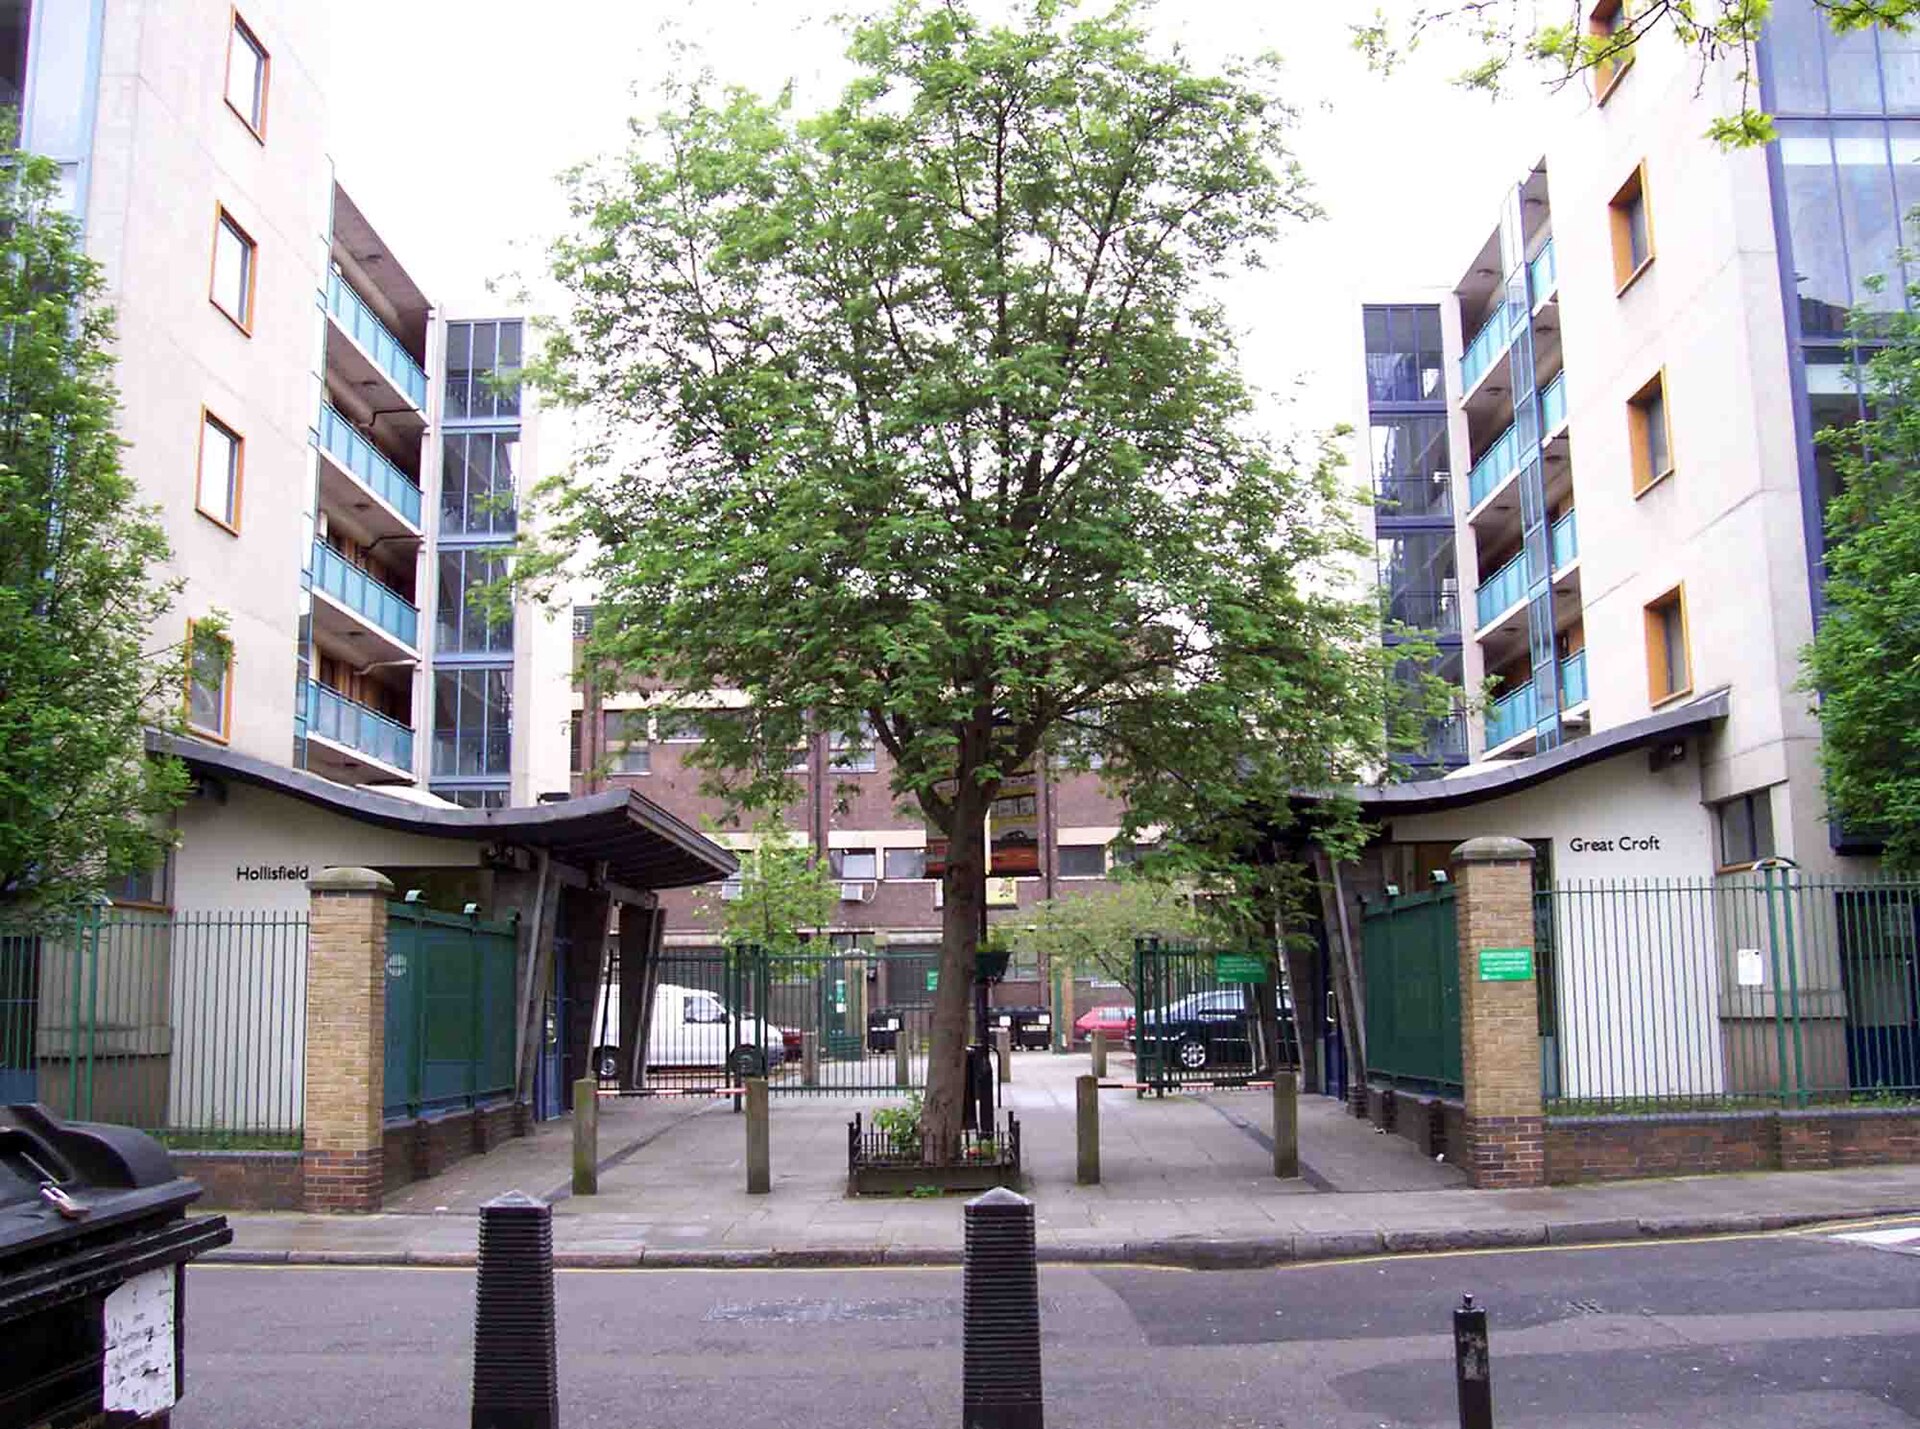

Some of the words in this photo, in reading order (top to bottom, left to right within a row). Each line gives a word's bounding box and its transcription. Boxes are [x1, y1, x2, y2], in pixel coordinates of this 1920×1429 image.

[1569, 837, 1614, 853] Great
[1619, 835, 1660, 851] Croft
[236, 865, 309, 881] Hollisfield
